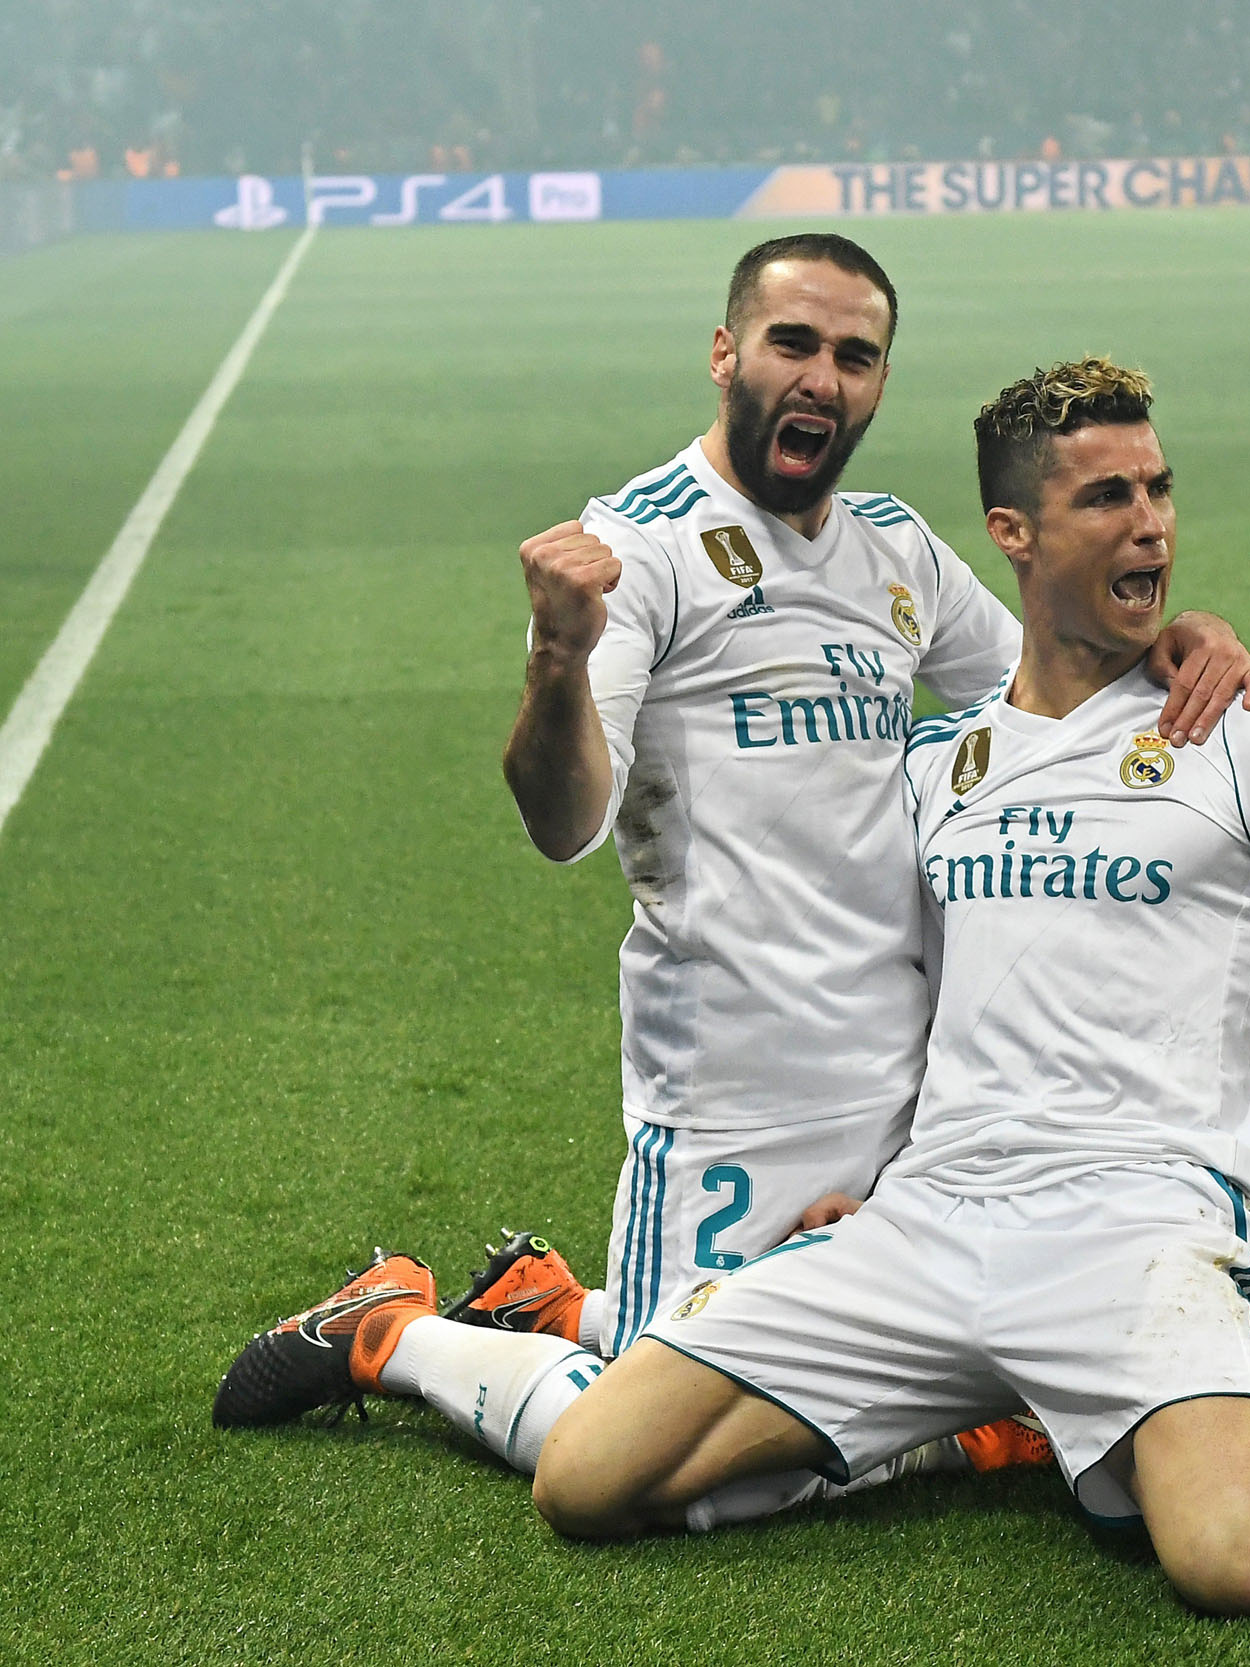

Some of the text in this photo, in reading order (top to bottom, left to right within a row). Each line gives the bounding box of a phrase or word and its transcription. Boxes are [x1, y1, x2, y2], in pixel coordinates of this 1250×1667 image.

[306, 173, 515, 225] PS4
[832, 164, 928, 212] THE
[941, 161, 1110, 211] SUPER
[730, 565, 754, 575] FIFA
[727, 602, 775, 619] adidas
[820, 643, 886, 686] Fly
[957, 769, 979, 784] FIFA
[999, 806, 1074, 844] Fly
[694, 1162, 753, 1270] 2
